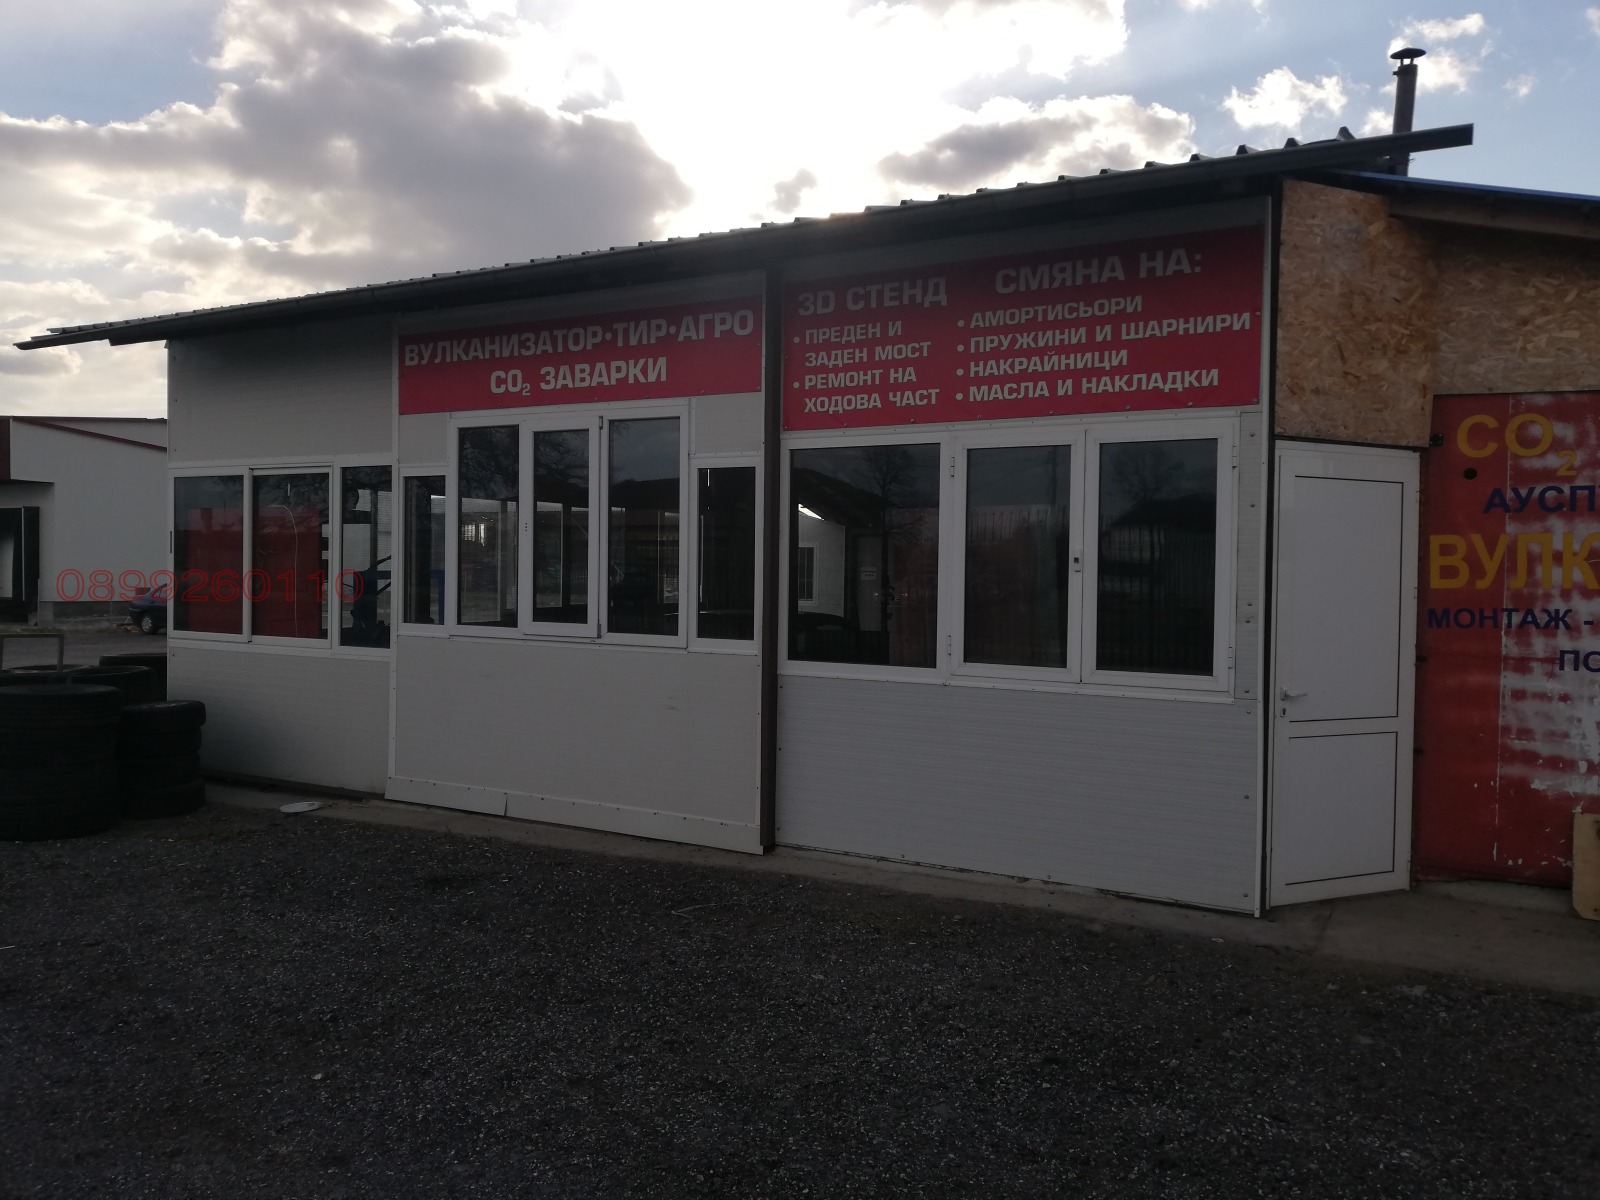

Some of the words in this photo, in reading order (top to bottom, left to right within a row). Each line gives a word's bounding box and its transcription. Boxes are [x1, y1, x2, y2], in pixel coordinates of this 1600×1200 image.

[995, 255, 1125, 294] СМЯНА
[1139, 248, 1202, 279] НА:
[798, 290, 836, 316] 3D
[846, 277, 948, 311] СТЕНД
[970, 295, 1142, 329] АМОРТИСЬОРИ
[805, 322, 881, 345] ПРЕДЕН
[888, 320, 902, 337] И
[969, 327, 1086, 354] ПРУЖИНИ
[1095, 324, 1112, 343] И
[1121, 312, 1251, 340] ШАРНИРИ
[804, 347, 868, 368] ЗАДЕН
[874, 341, 932, 361] МОСТ
[969, 349, 1128, 378] НАКРАЙНИЦИ
[539, 356, 667, 391] ЗАВАРКИ
[804, 369, 883, 390] РЕМОНТ
[889, 366, 917, 384] НА
[969, 380, 1050, 402] МАСЛА
[1057, 378, 1073, 396] И
[1081, 368, 1219, 394] НАКЛАДКИ
[804, 393, 882, 414] ХОДОВА
[888, 388, 940, 407] ЧАСТ
[1483, 485, 1600, 514] АУСП
[1427, 608, 1572, 630] МОНТАЖ
